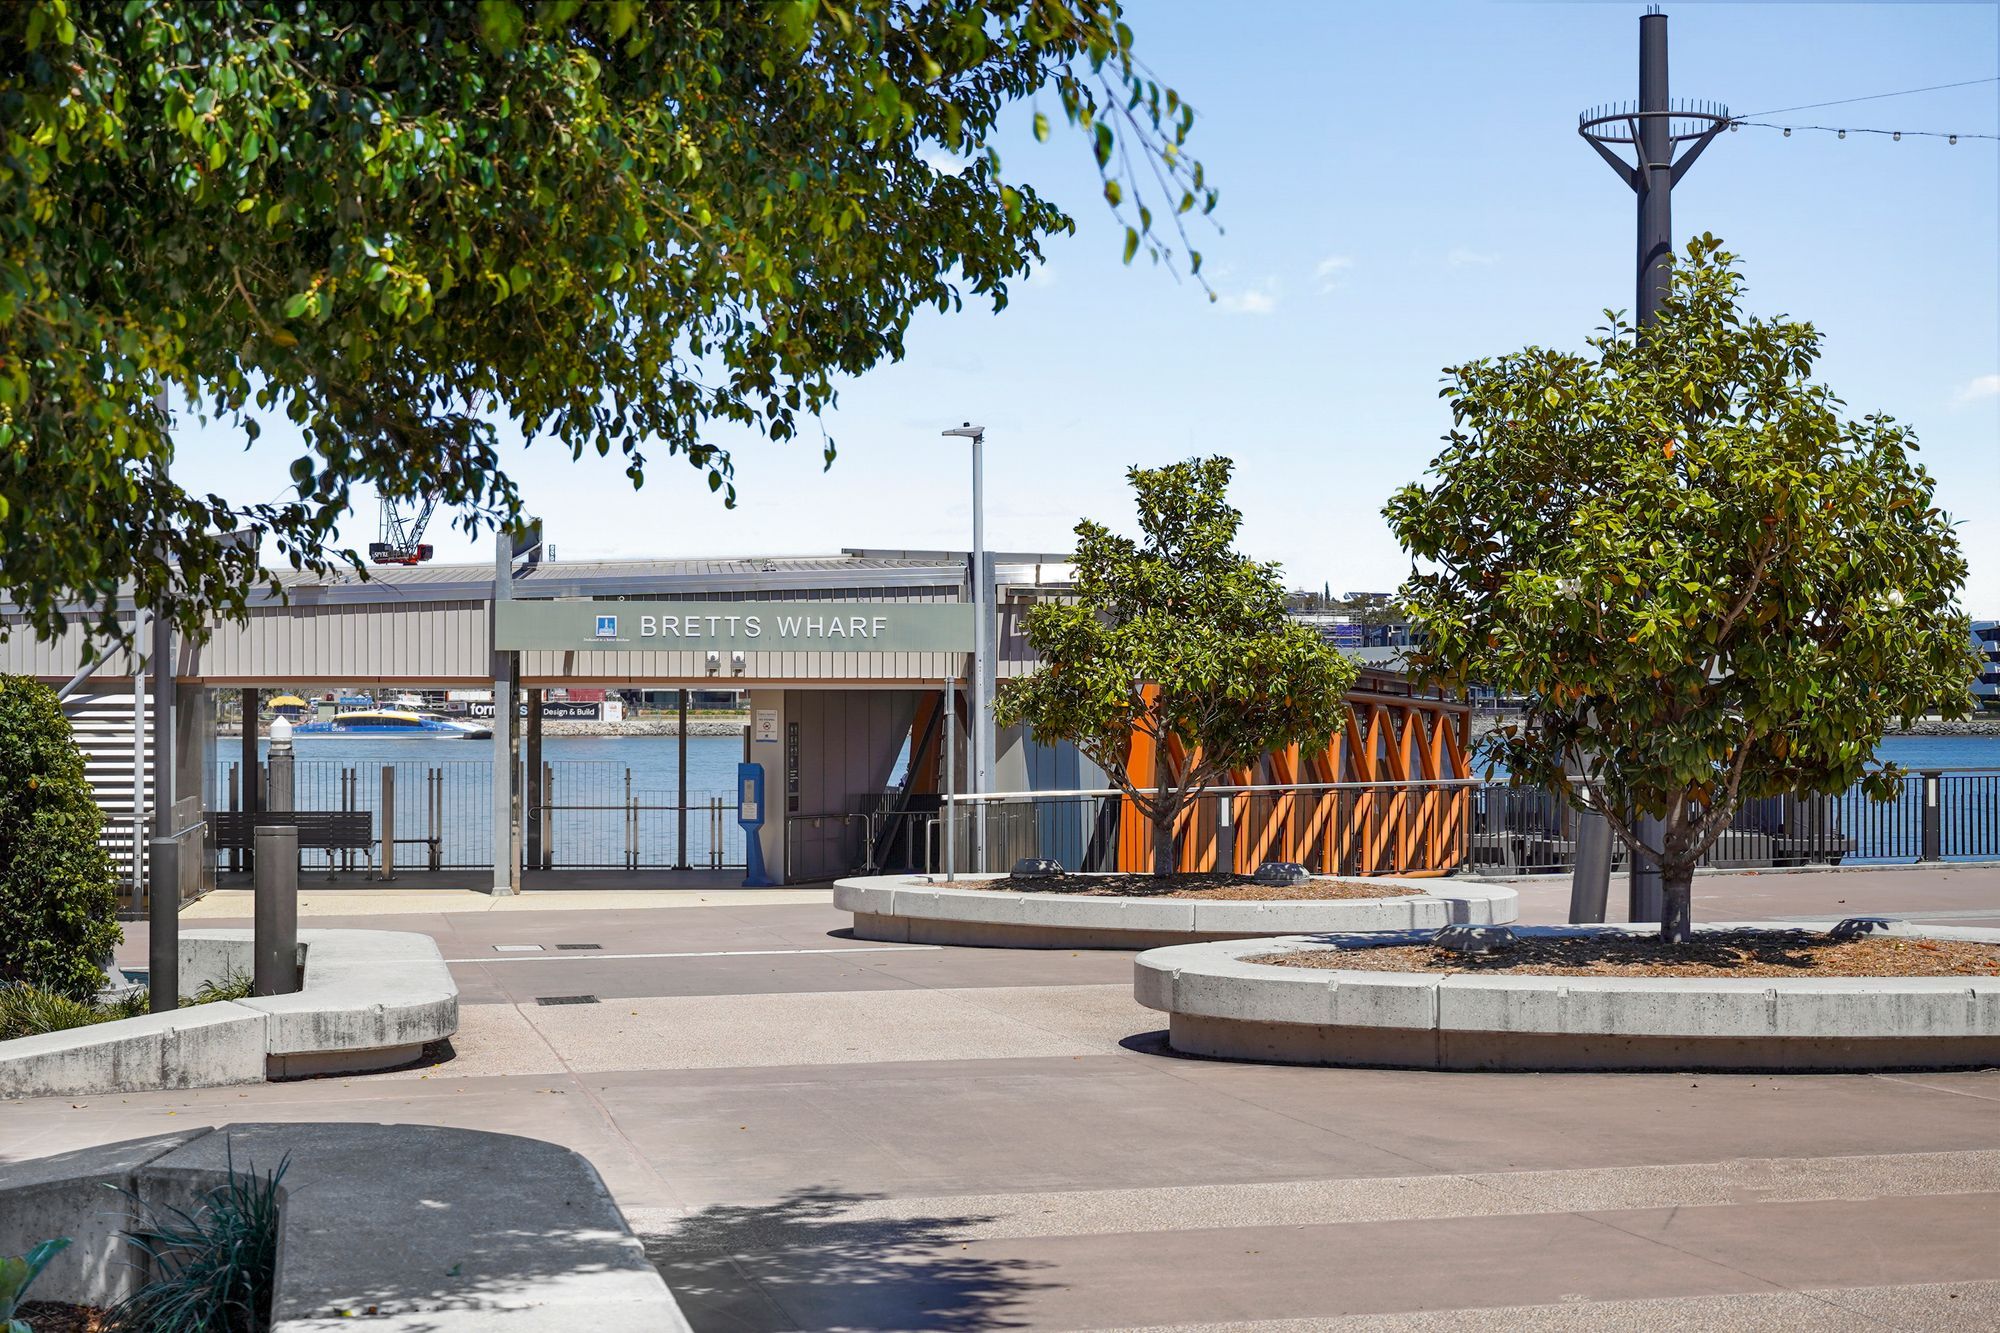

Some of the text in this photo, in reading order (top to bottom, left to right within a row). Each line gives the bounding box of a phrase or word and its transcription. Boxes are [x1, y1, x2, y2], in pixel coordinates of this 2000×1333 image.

[640, 615, 887, 638] BRETTS WHARF
[543, 708, 595, 719] Design & Build
